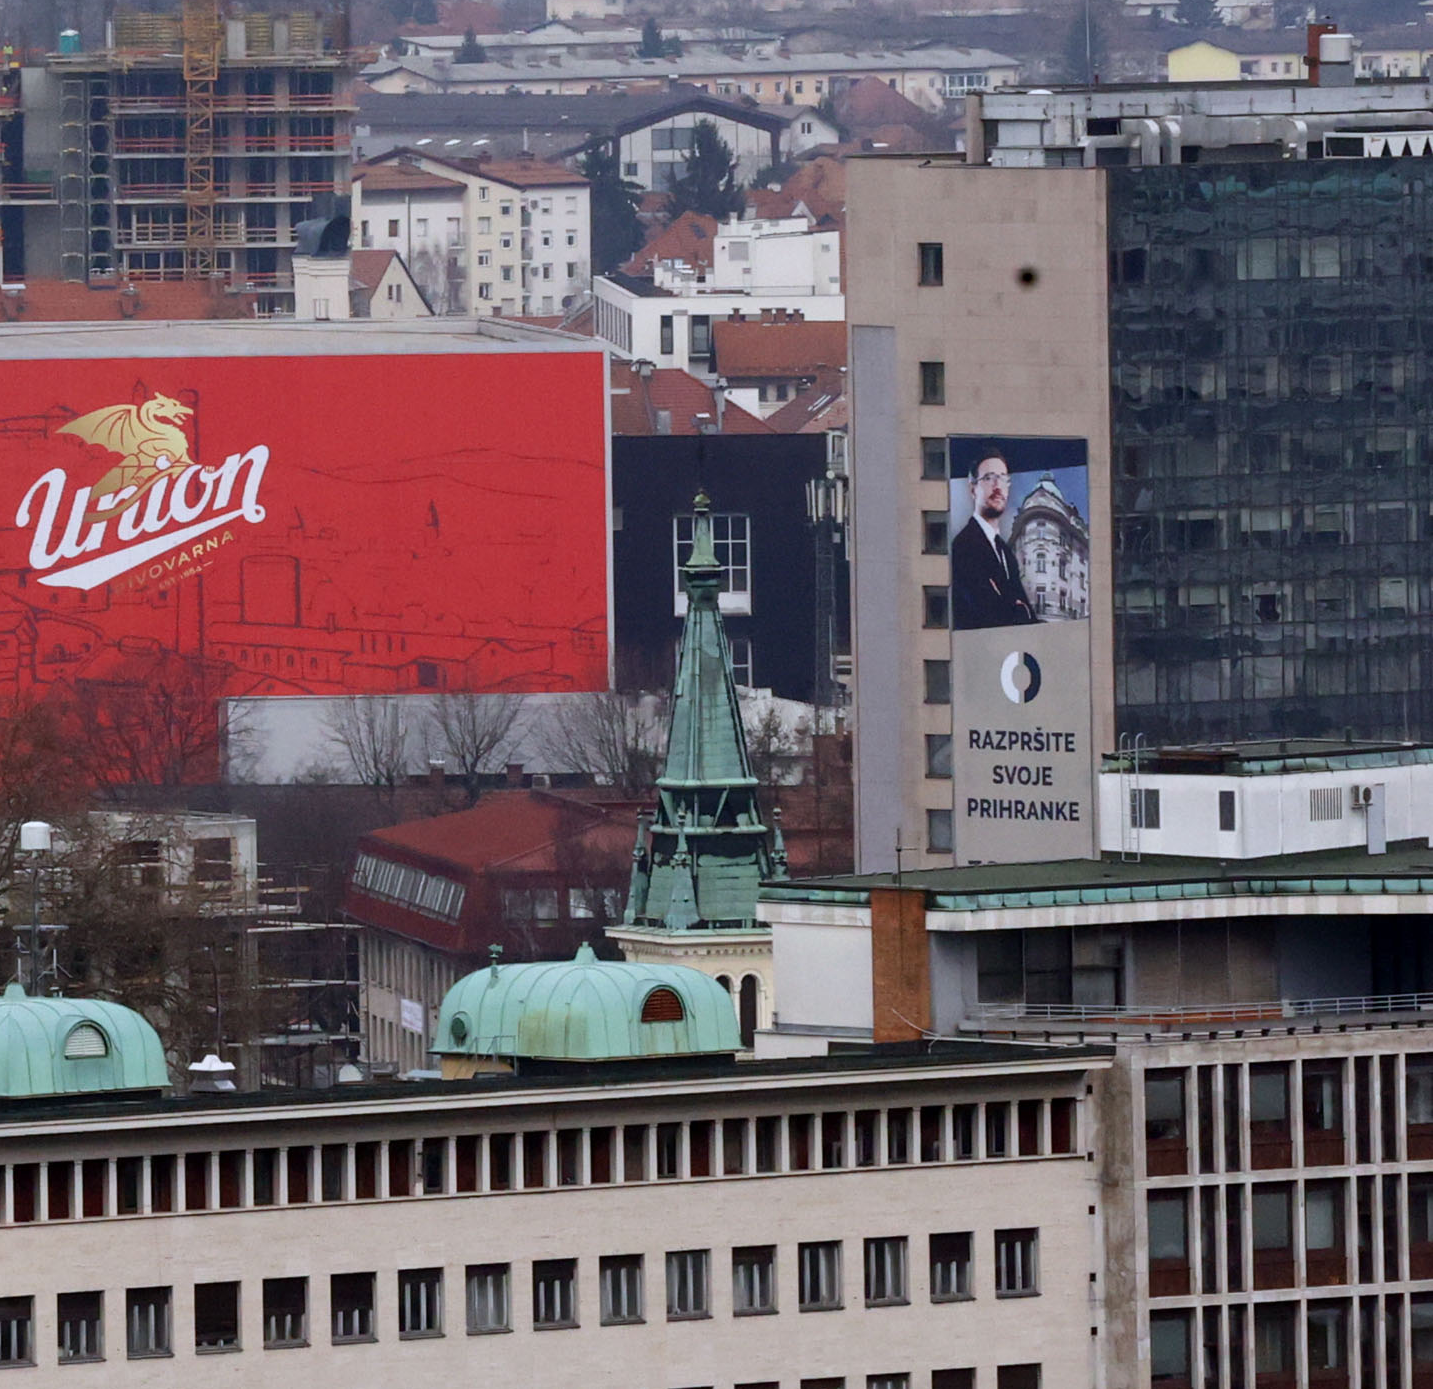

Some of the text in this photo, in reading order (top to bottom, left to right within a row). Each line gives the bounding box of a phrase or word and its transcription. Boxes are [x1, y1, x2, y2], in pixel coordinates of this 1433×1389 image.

[15, 444, 270, 571] Union
[969, 727, 1076, 753] RAZPRŠITE
[992, 765, 1053, 786] SVOJE
[967, 798, 1080, 821] PRIHRANKE
